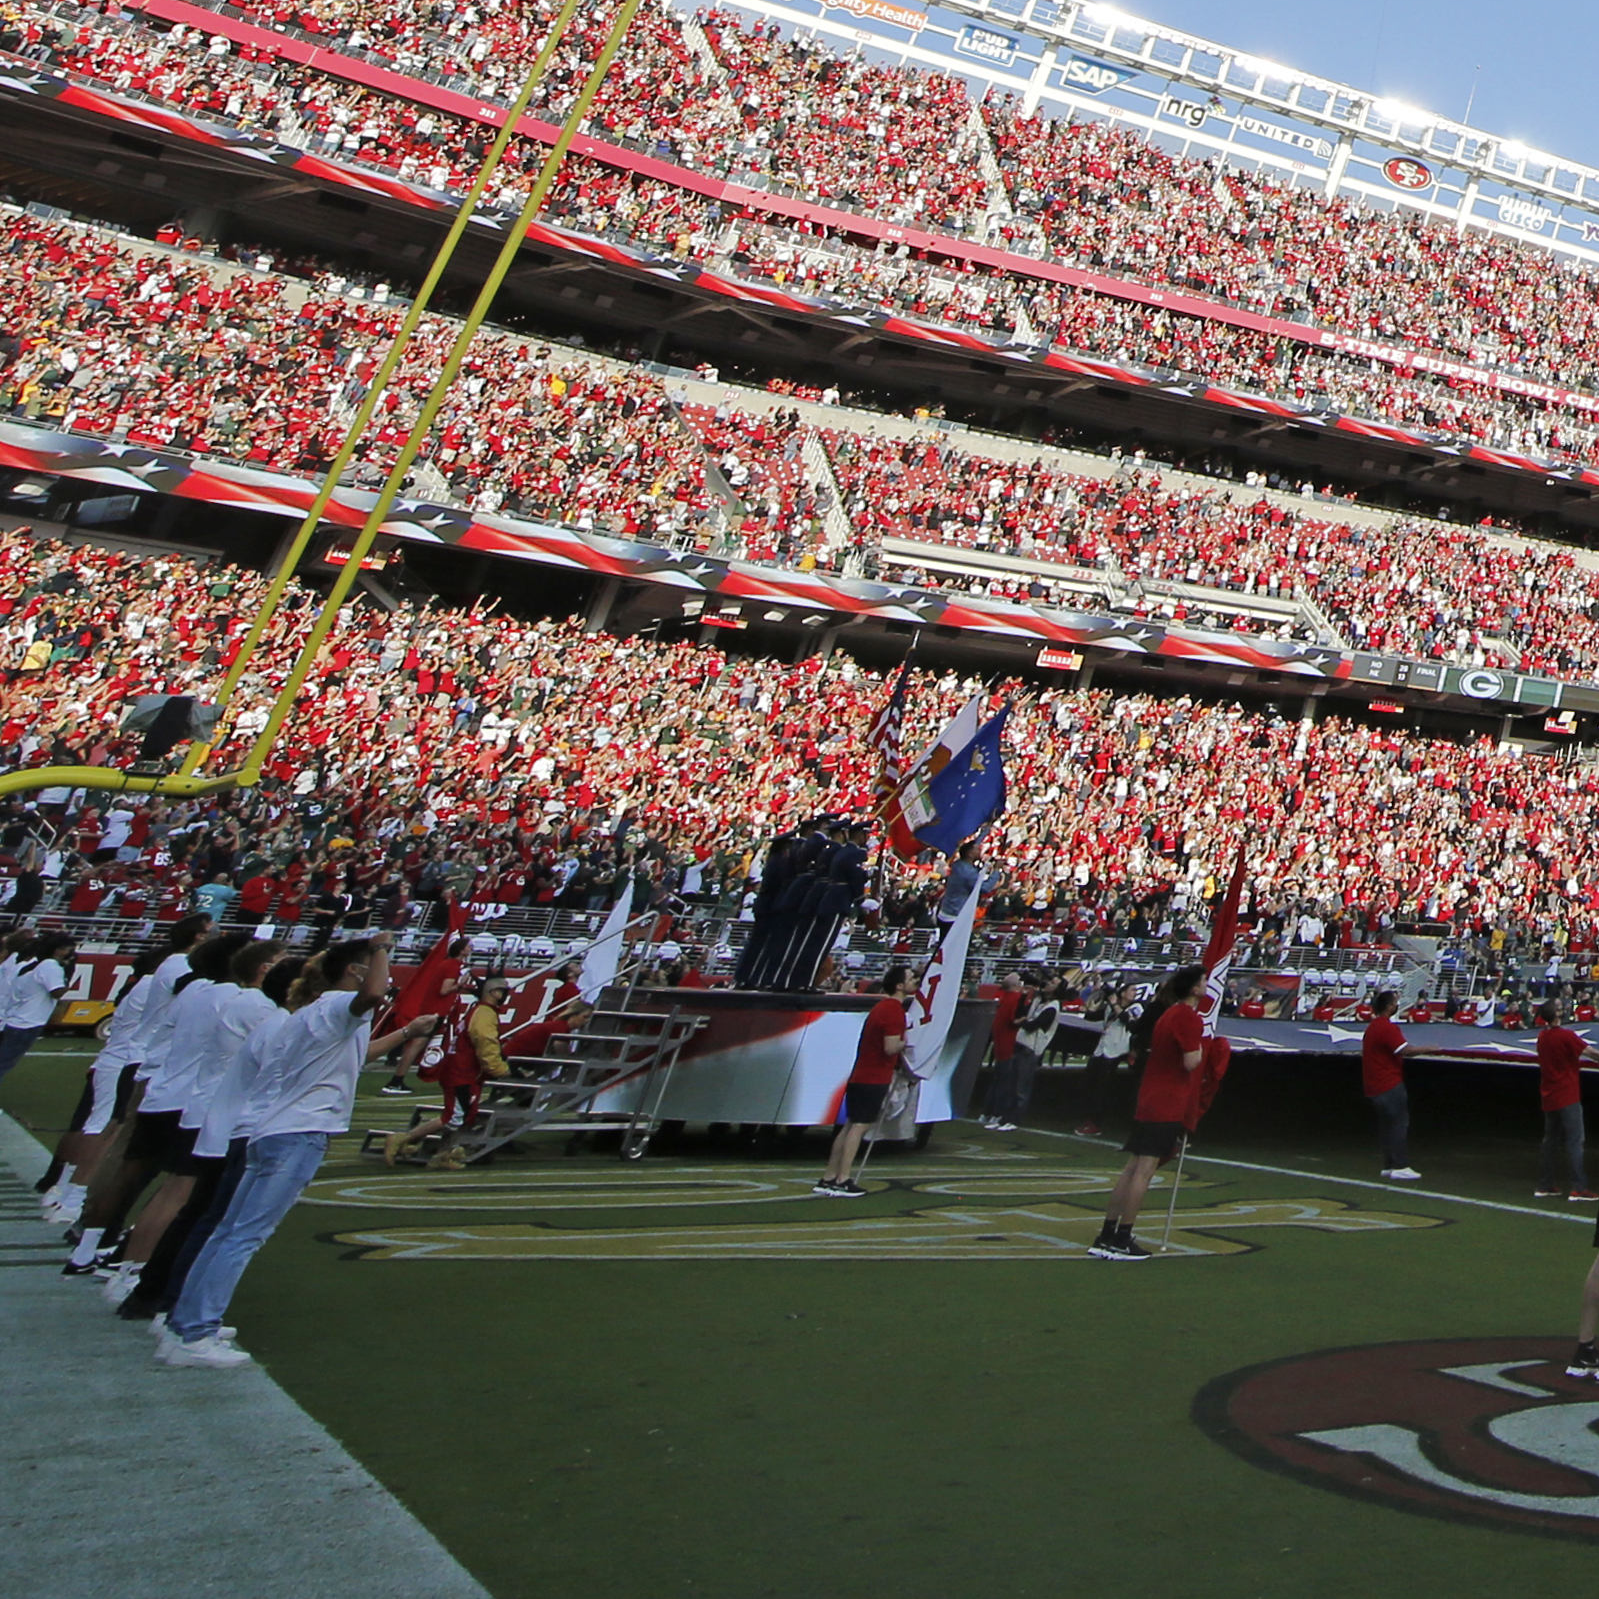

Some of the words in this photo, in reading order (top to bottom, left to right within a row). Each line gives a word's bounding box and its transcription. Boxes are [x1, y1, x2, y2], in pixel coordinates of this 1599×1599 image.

[872, 2, 925, 29] Health
[962, 37, 1013, 61] LIGHT
[970, 25, 1011, 47] BUD
[1068, 60, 1119, 89] SAP
[1165, 97, 1207, 126] nrg
[1244, 118, 1315, 149] UNITED
[1410, 353, 1491, 385] SUPER
[1495, 373, 1565, 401] BOWL
[1416, 666, 1437, 677] FINAL
